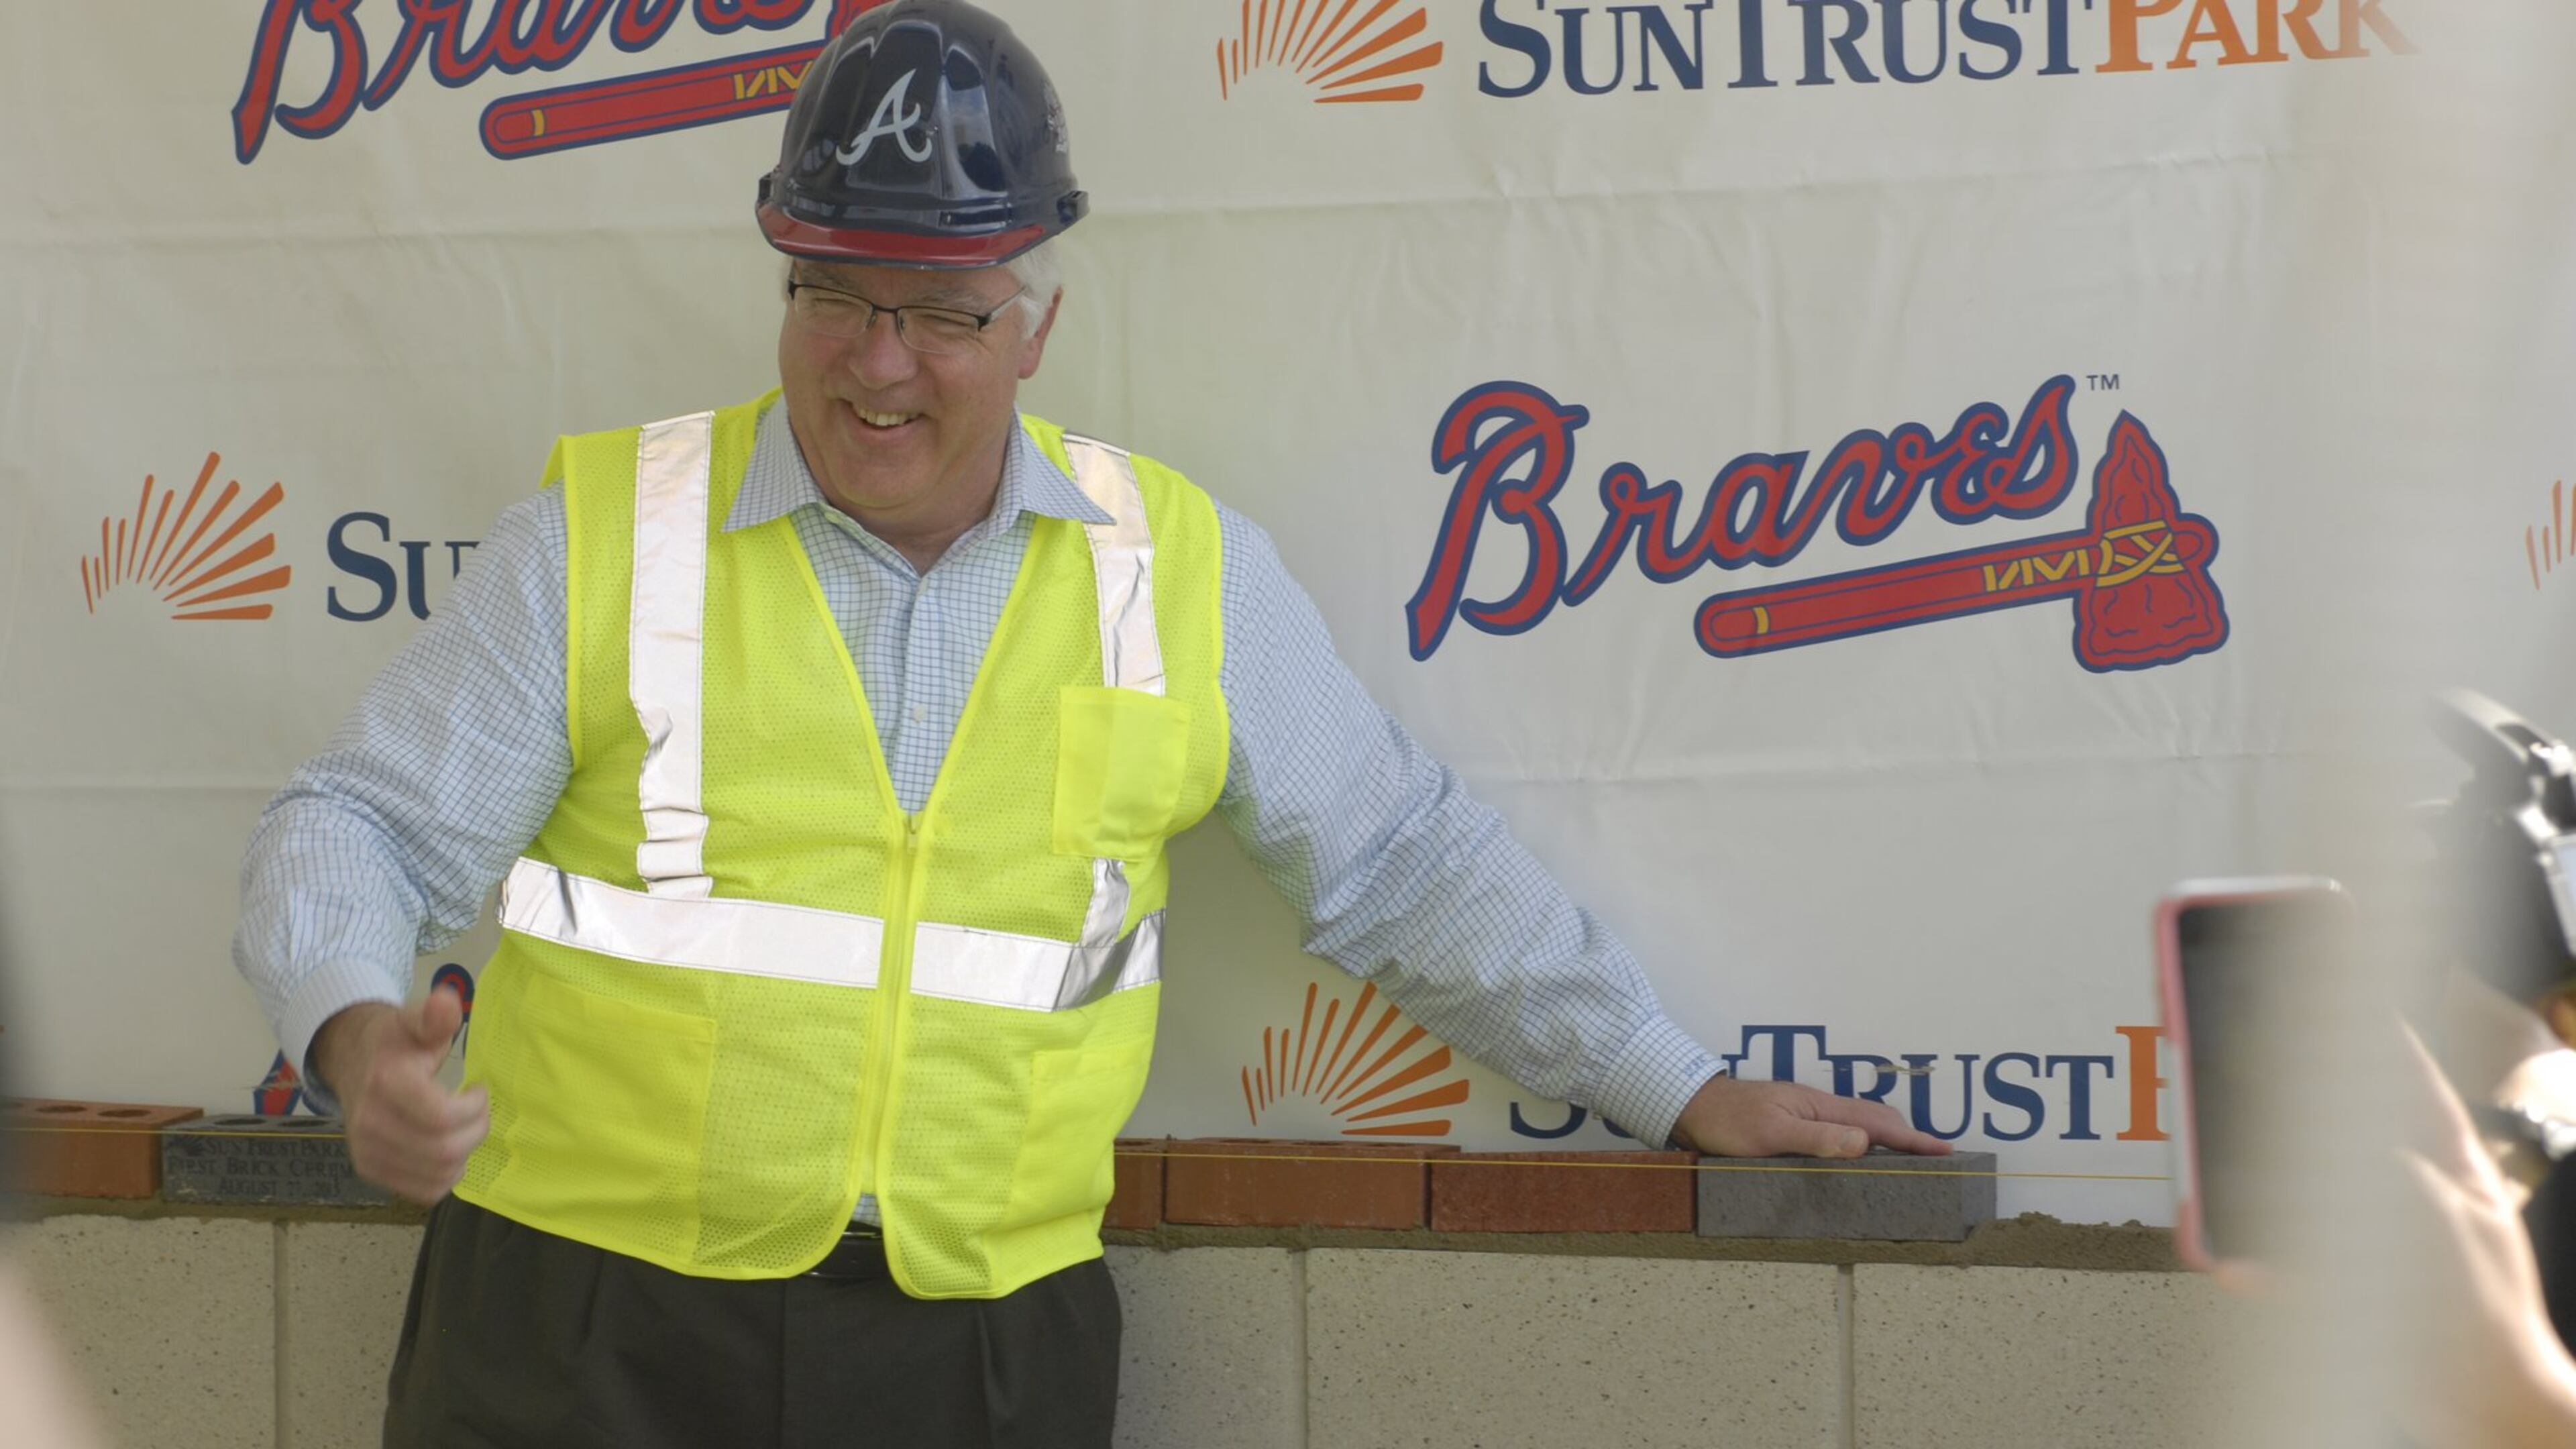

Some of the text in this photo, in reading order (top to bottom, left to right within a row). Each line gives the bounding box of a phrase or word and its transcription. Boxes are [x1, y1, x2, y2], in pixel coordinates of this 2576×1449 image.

[835, 68, 932, 166] A
[2086, 374, 2120, 390] TM
[1405, 374, 2078, 661] Braves
[226, 1157, 279, 1175] BRICK
